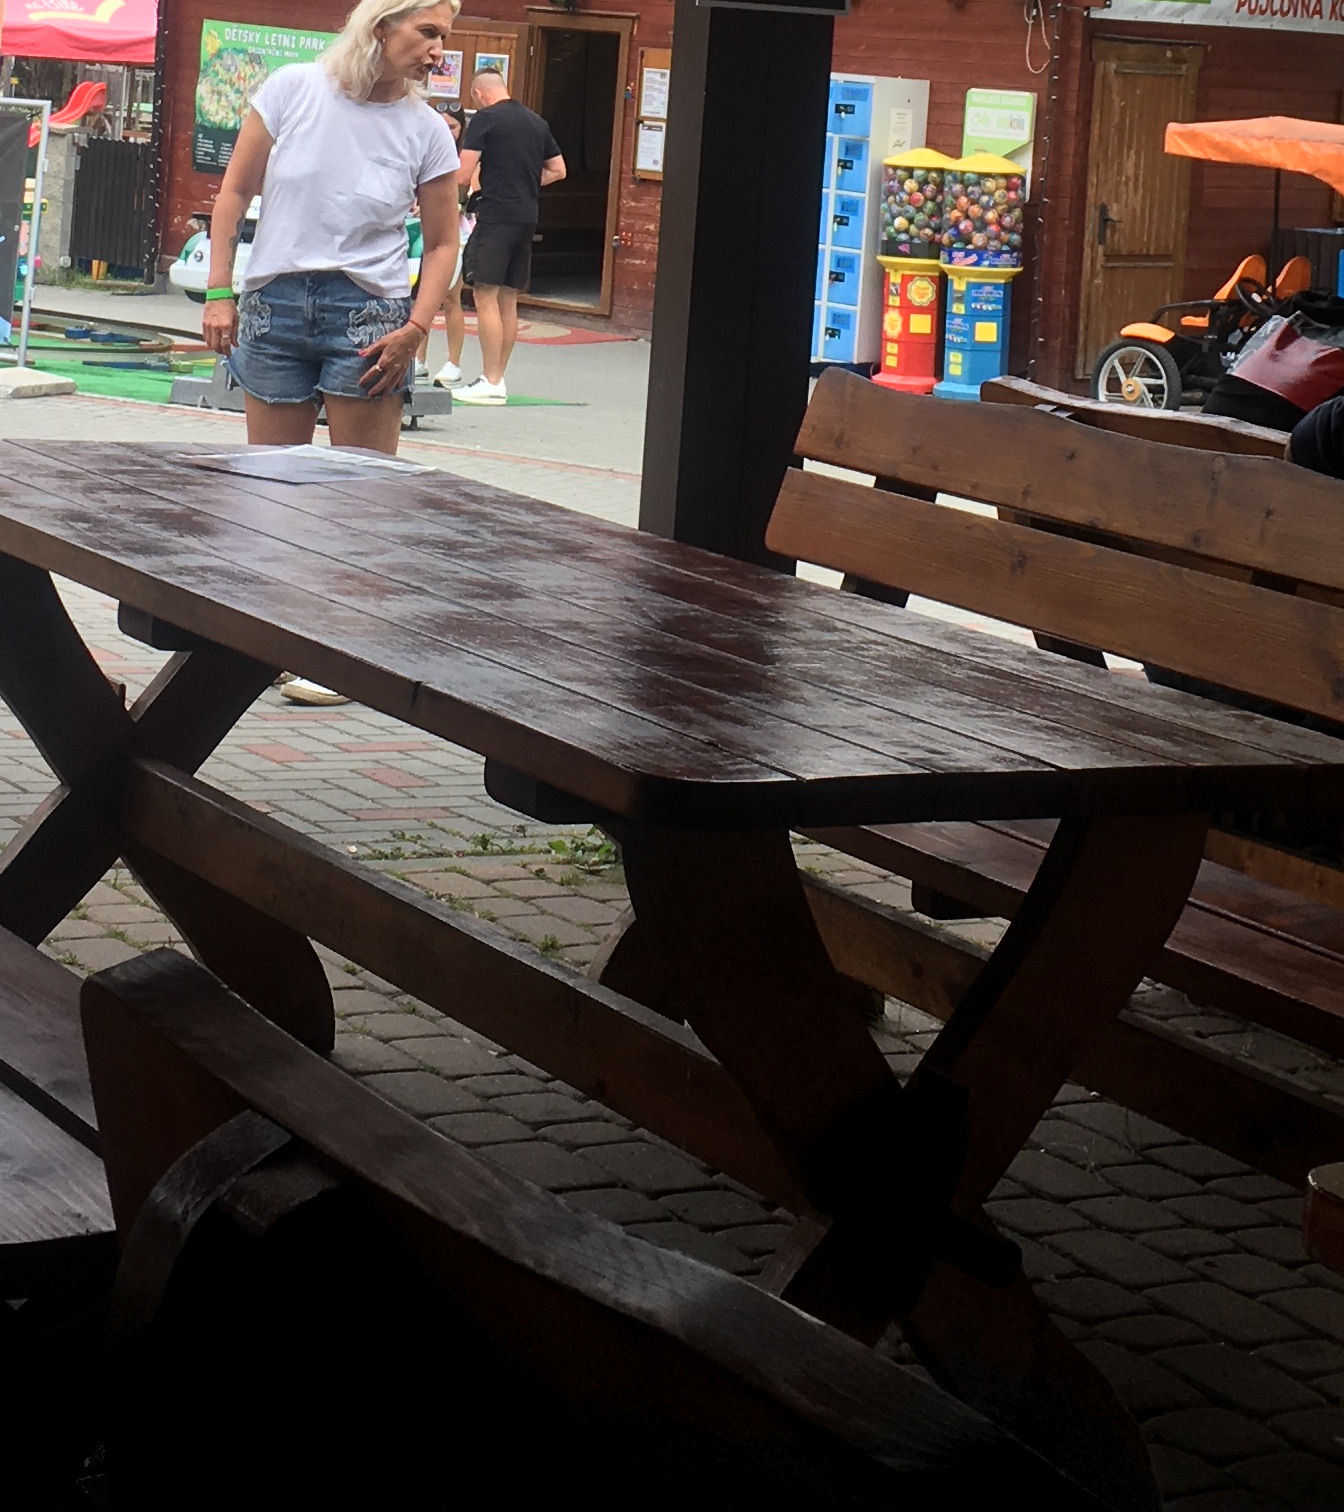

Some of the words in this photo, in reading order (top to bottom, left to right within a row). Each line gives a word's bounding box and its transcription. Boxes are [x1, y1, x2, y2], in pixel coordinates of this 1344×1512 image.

[224, 24, 262, 44] DĚTSKÝ
[264, 30, 297, 48] LETNÍ
[298, 36, 327, 51] PARK
